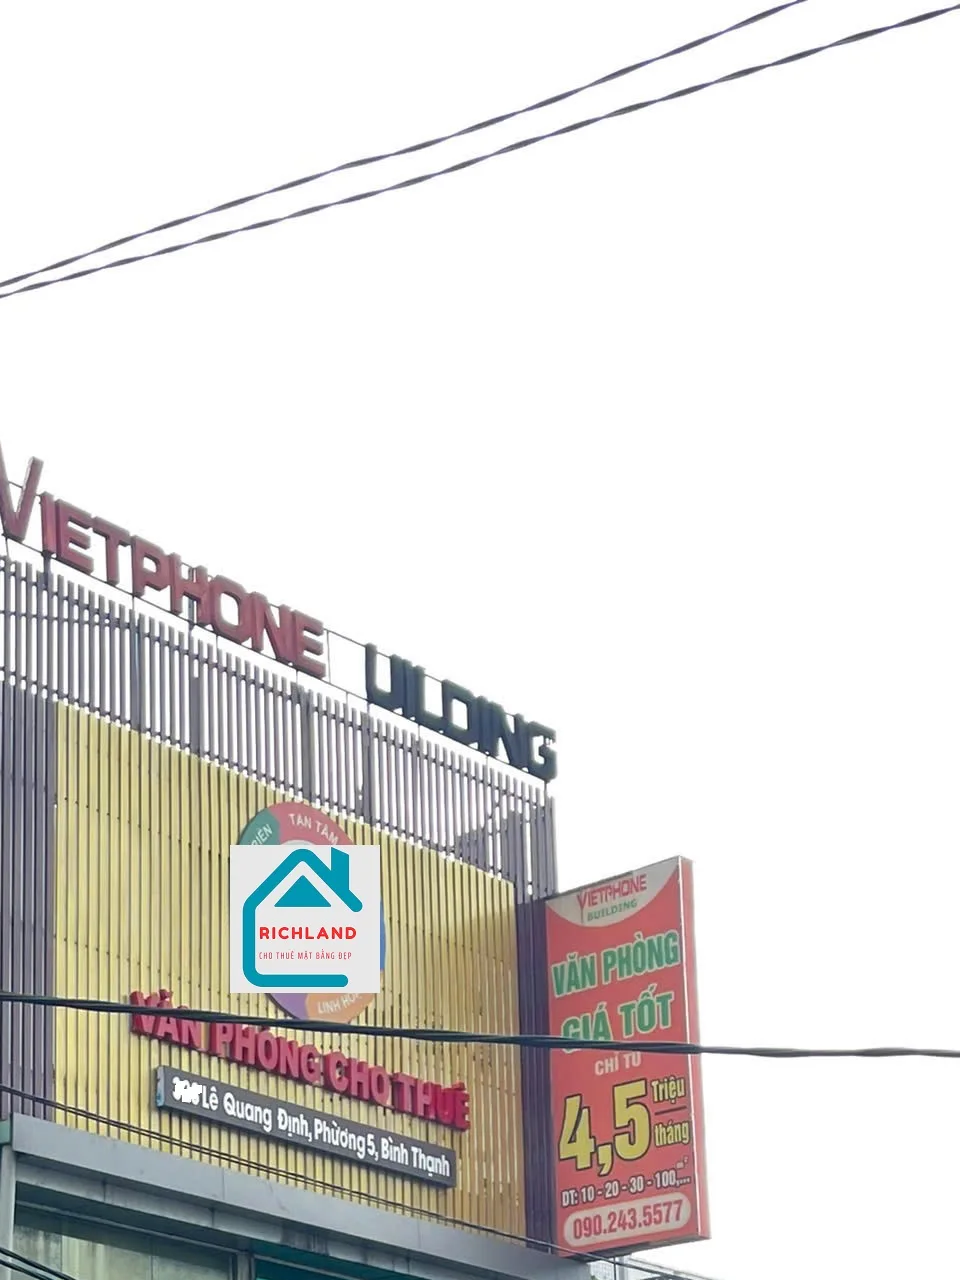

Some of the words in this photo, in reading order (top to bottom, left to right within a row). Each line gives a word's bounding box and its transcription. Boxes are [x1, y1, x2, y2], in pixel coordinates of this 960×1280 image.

[577, 874, 648, 913] VIETPHONE
[587, 899, 638, 921] BUILDING
[552, 954, 596, 996] VĂN
[602, 932, 680, 984] PHÒNG
[561, 1003, 613, 1052] GIÁ
[619, 984, 674, 1037] TỐT
[324, 1050, 391, 1107] CHO
[391, 1072, 471, 1132] THUÊ
[651, 1075, 686, 1104] Triệu
[202, 1086, 218, 1111] Lê
[223, 1092, 272, 1132] Quang
[381, 1139, 408, 1167] Bình
[411, 1145, 450, 1178] Thạnh
[558, 1079, 651, 1176] 4,5
[654, 1120, 689, 1147] tháng
[561, 1190, 578, 1208] DT:
[581, 1186, 595, 1203] 10
[604, 1180, 620, 1199] 20
[629, 1175, 644, 1194] 30
[573, 1200, 683, 1239] 090.243.5577
